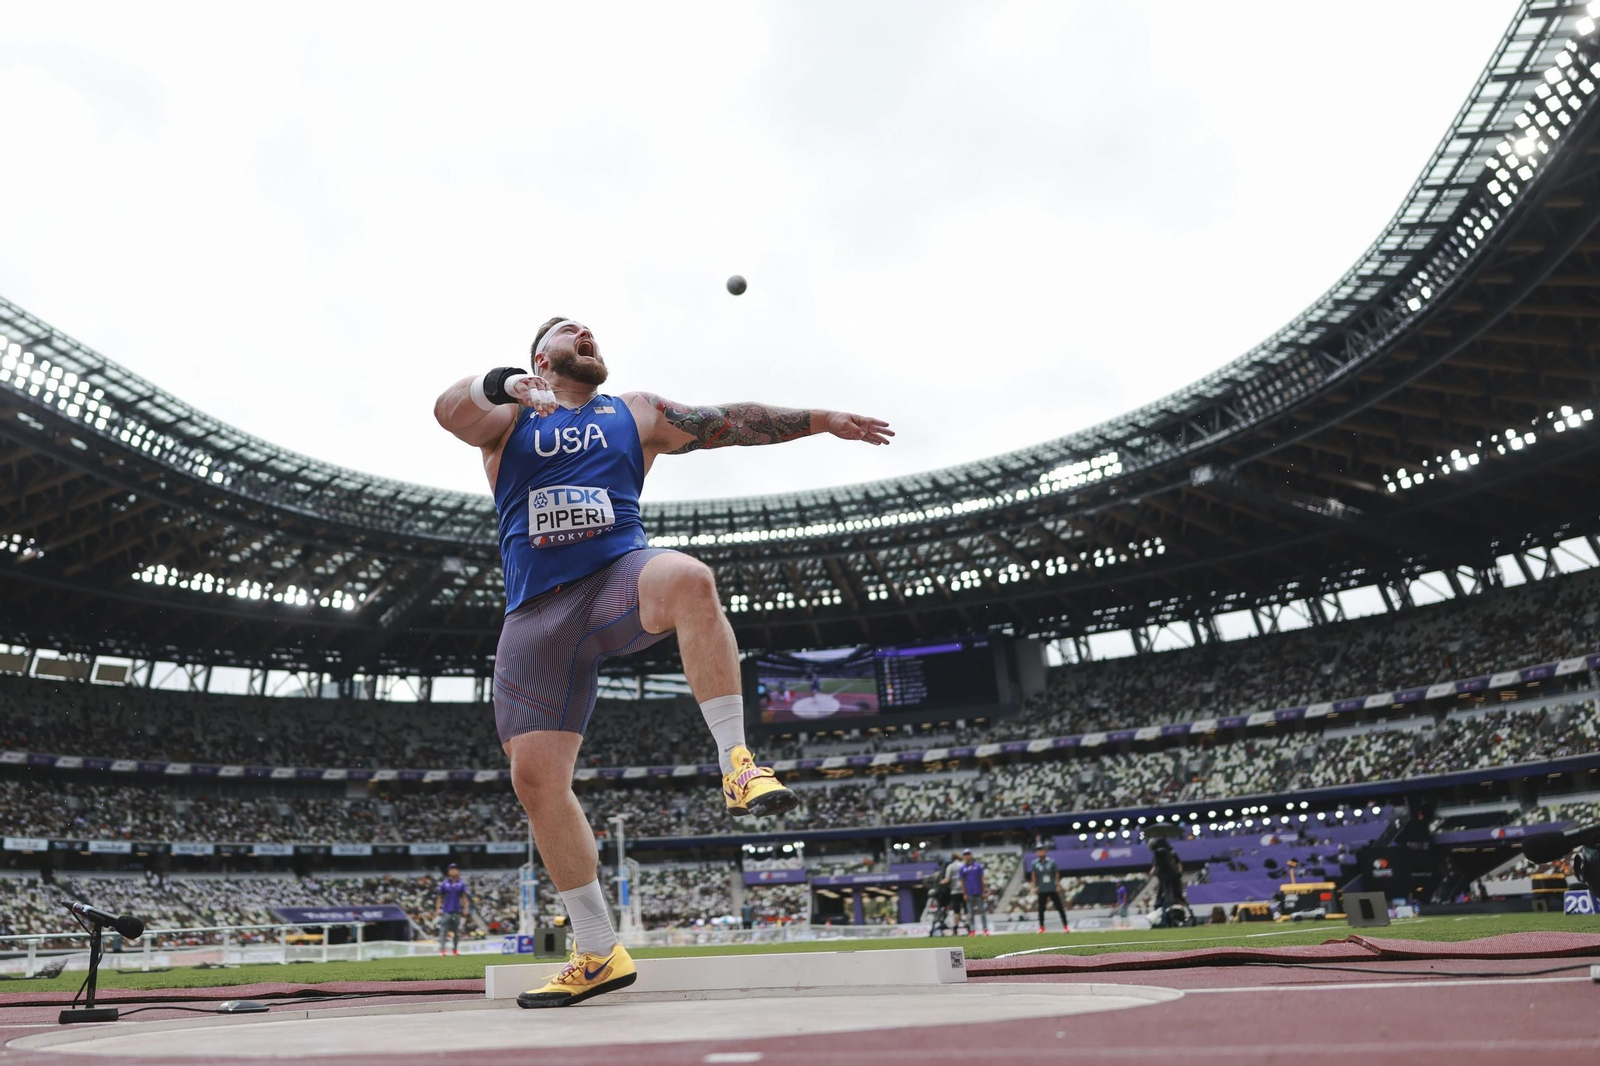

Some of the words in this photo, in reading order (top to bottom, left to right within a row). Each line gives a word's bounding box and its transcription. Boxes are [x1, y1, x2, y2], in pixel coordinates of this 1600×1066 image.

[535, 423, 608, 457] USA
[547, 488, 604, 506] TDK
[536, 508, 606, 531] PIPERI
[1565, 895, 1590, 913] 20
